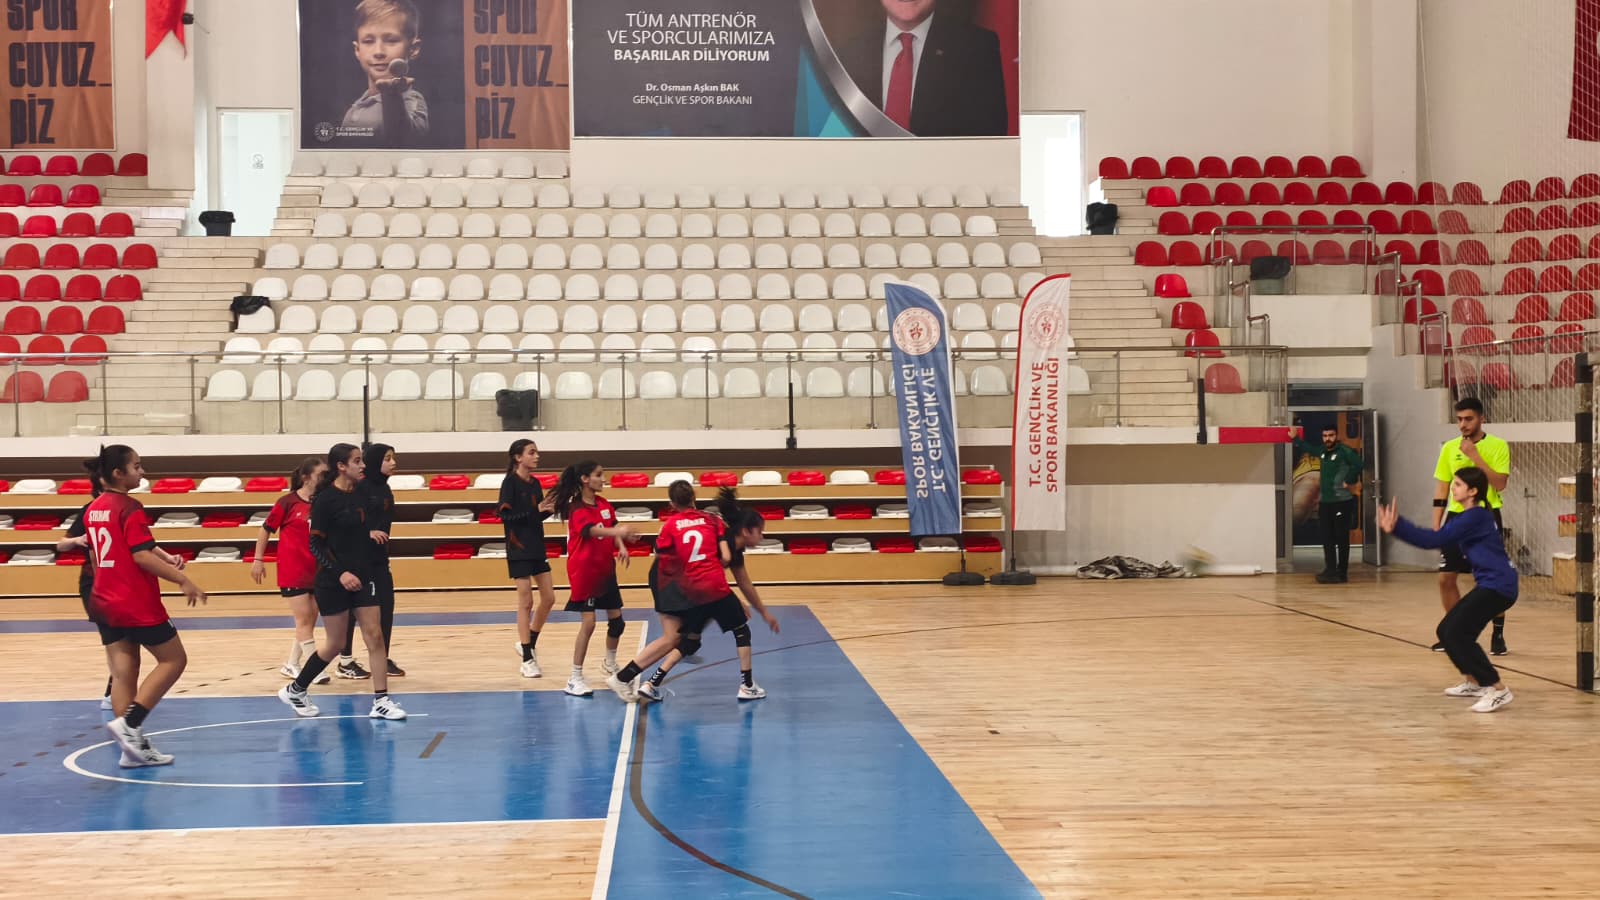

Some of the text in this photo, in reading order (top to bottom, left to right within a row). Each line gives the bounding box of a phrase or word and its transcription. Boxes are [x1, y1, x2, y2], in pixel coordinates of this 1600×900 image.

[626, 11, 756, 28] TÜM ANTRENÖR
[607, 30, 775, 45] VE SPORCULARIMIZA
[614, 48, 770, 63] BAŞARILAR DİLİYORUM
[645, 83, 659, 92] Dr.
[660, 83, 691, 92] Osman
[720, 83, 739, 92] BAK
[633, 95, 752, 107] GENÇLİK VE SPOR BAKANI
[1029, 362, 1044, 488] T.C. GENÇLİK VE
[1043, 357, 1059, 493] SPOR BAKANLIĞI
[88, 526, 115, 568] 12
[682, 530, 706, 562] 2
